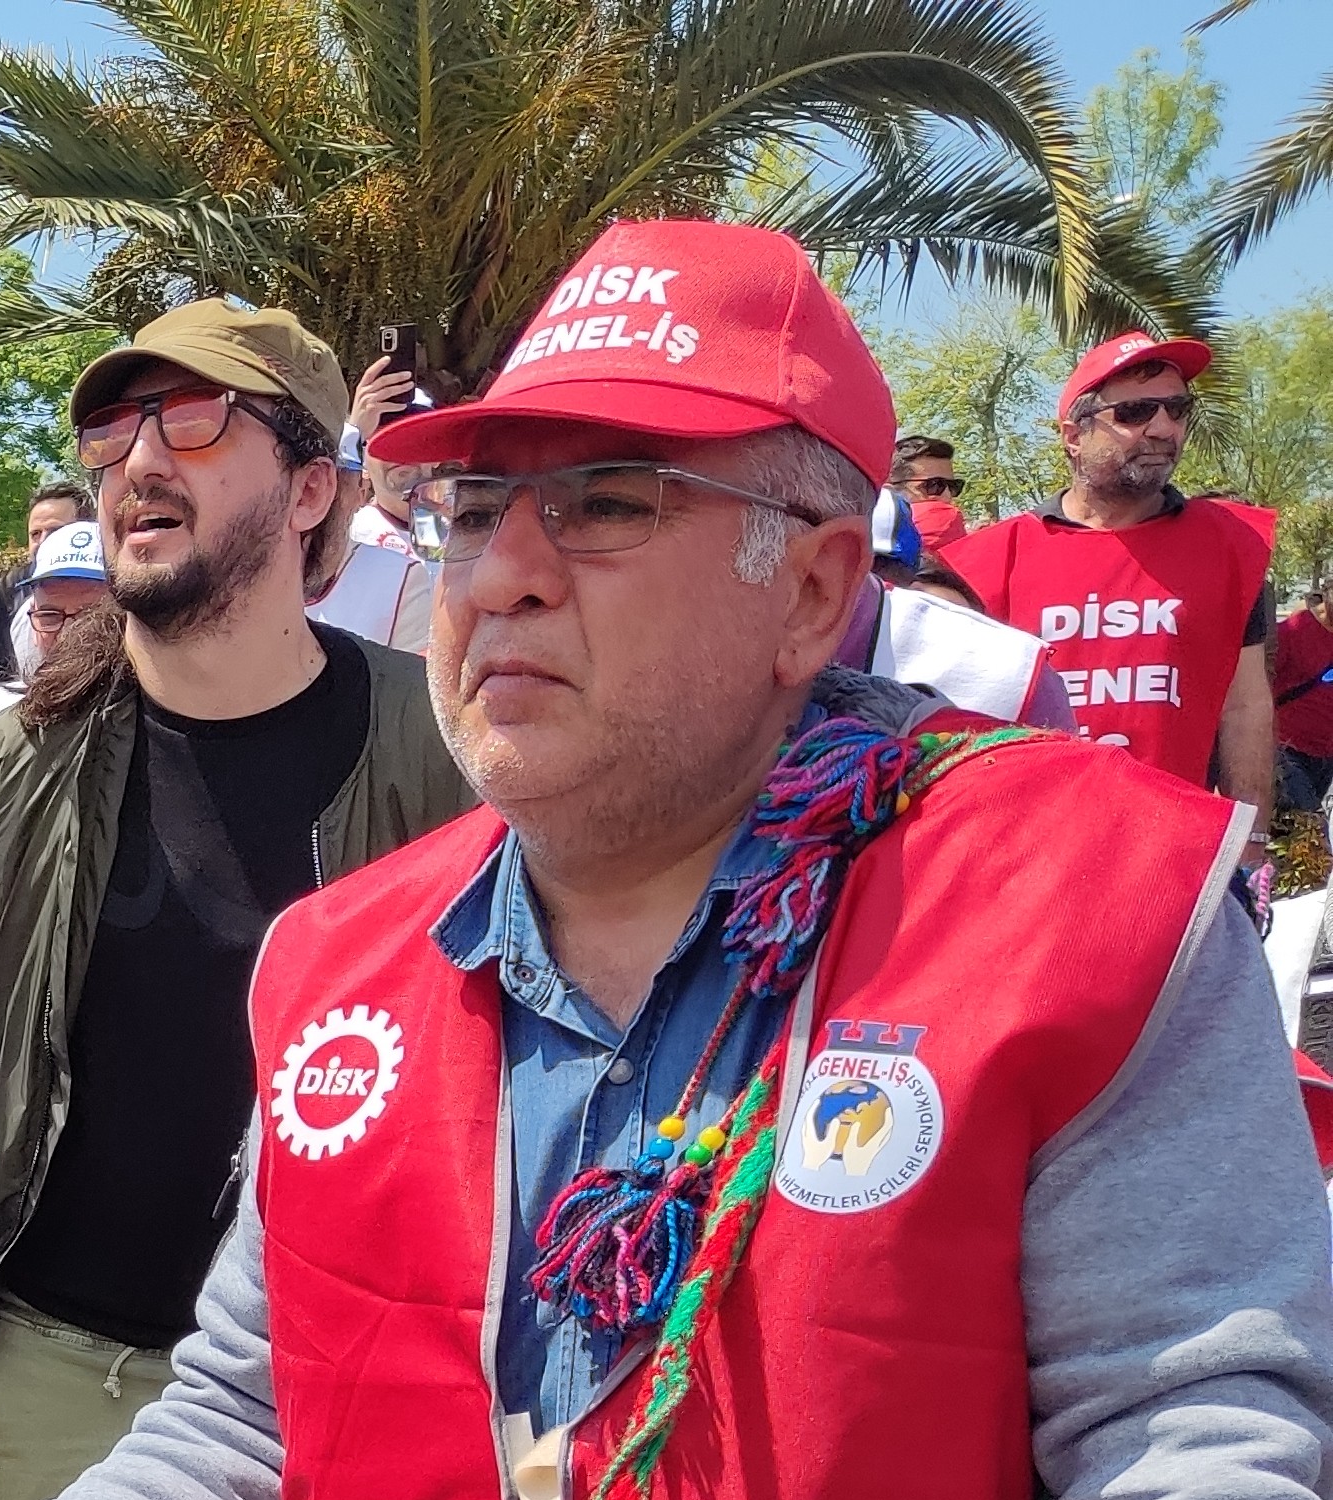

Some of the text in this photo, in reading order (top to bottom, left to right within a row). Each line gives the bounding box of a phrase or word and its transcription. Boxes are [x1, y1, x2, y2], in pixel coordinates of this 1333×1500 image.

[547, 264, 680, 318] DİSK
[502, 311, 700, 374] GENEL-İŞ
[1041, 593, 1183, 643] DİSK
[1057, 664, 1181, 709] ENEL
[297, 1055, 376, 1096] DİSK
[819, 1057, 910, 1087] GENEL-İŞ
[779, 1073, 934, 1209] HİZMETLER İŞÇİLERİ SENDİKASI
